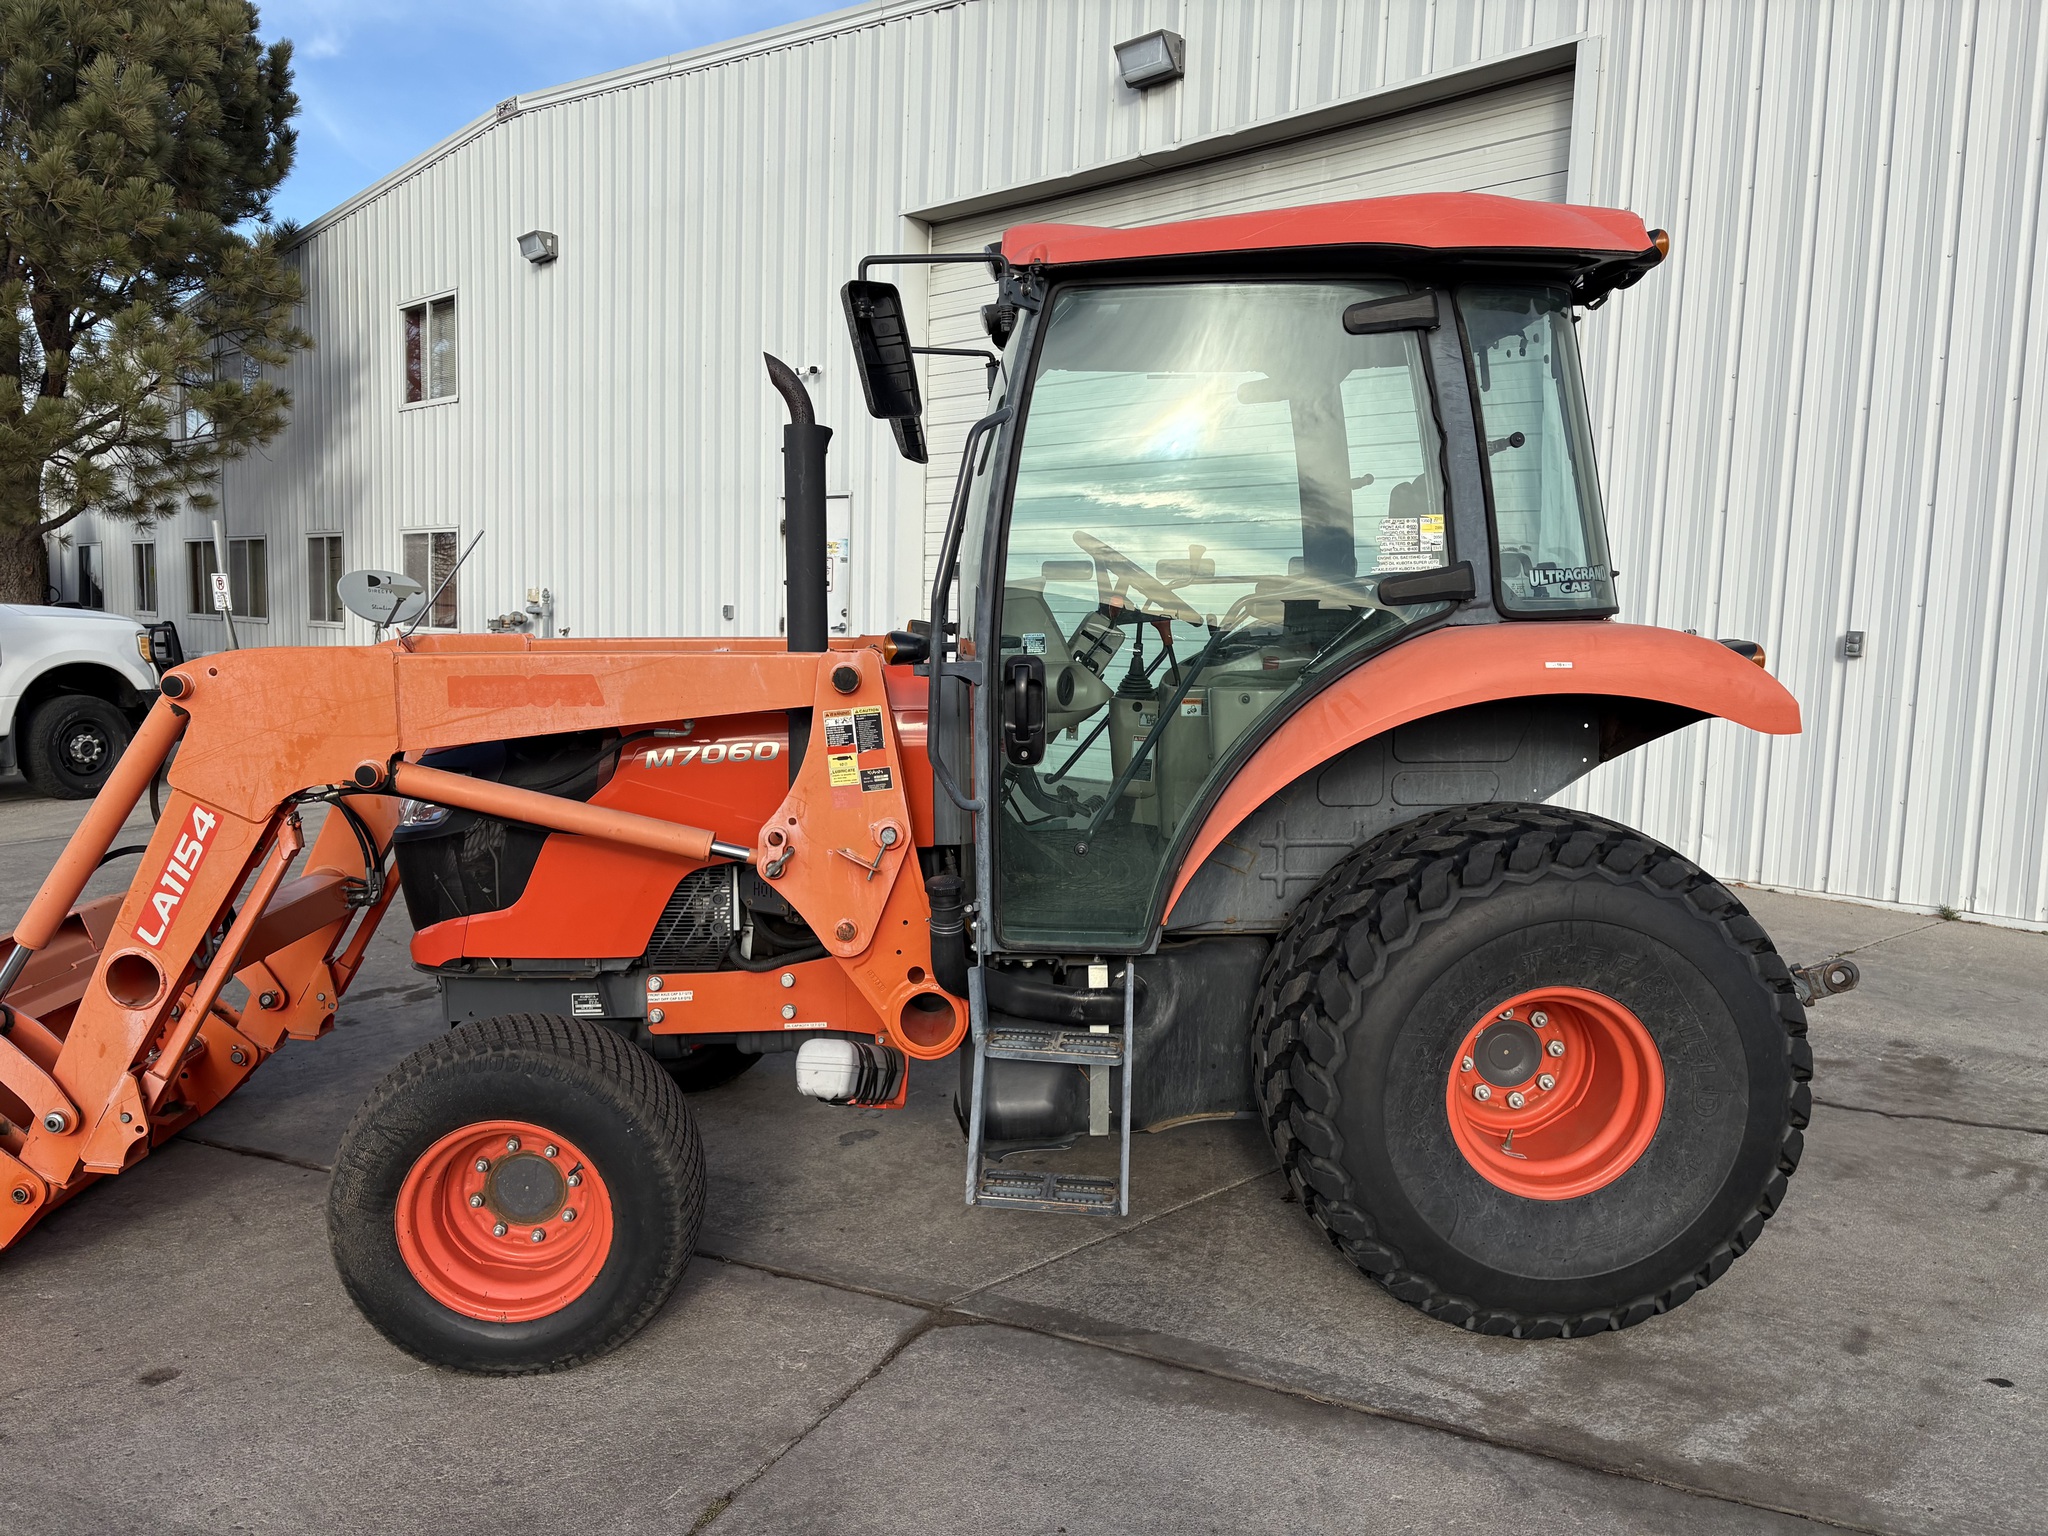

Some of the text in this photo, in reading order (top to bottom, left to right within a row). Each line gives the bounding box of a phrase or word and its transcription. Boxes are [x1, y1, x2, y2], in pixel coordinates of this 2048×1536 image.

[1529, 564, 1607, 588] ULTRAGRAND
[1560, 580, 1591, 593] CAB
[644, 742, 780, 769] M7060
[136, 805, 217, 947] LA1154
[1521, 944, 1639, 977] TURF
